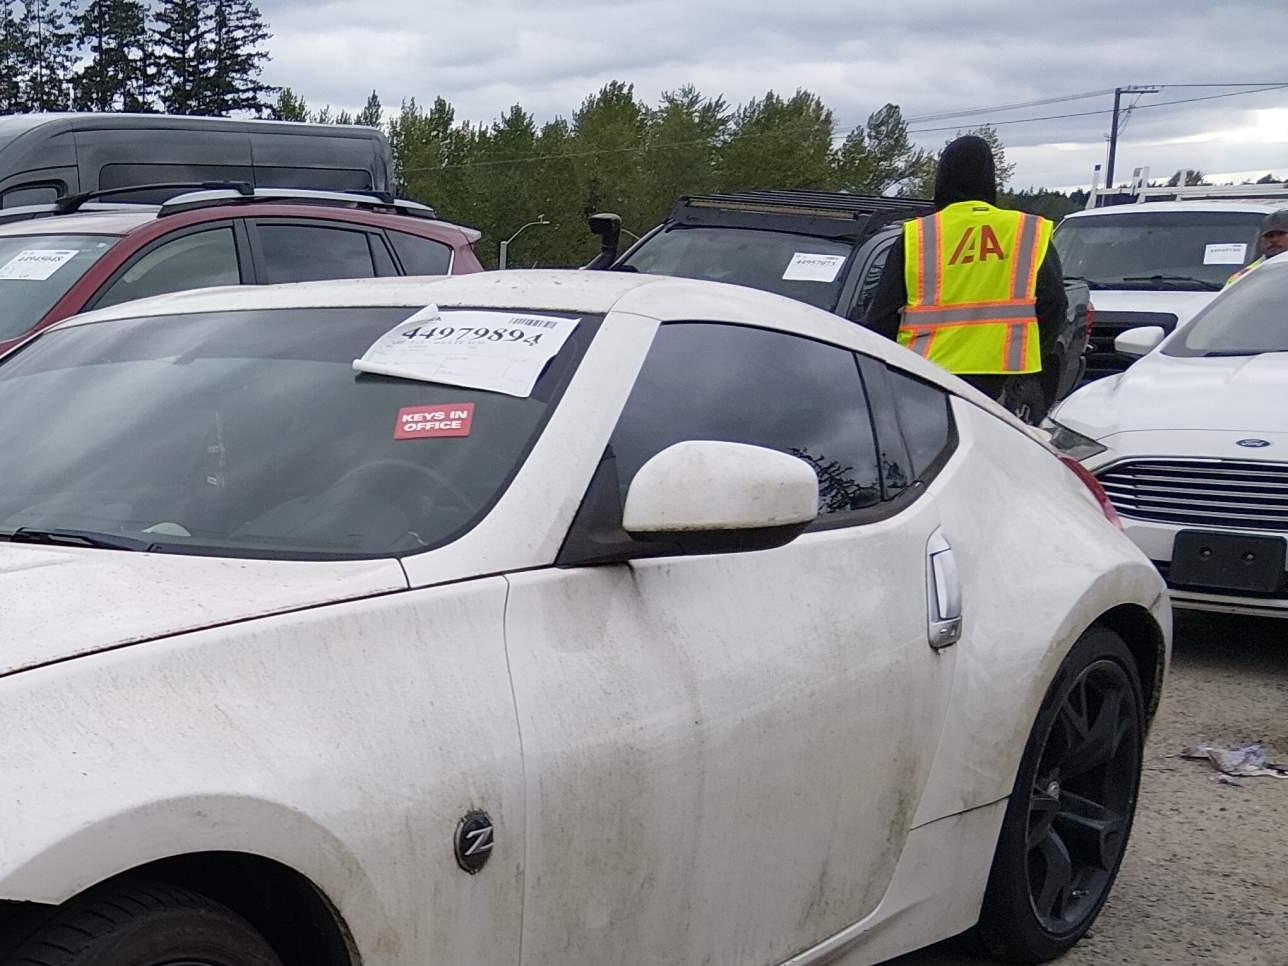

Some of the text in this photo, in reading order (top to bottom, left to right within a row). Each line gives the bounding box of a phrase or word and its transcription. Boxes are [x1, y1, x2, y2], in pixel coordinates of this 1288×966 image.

[401, 326, 543, 347] 44979894
[401, 410, 468, 423] KEYS IN
[403, 420, 462, 432] OFFICE
[463, 825, 496, 856] Z
